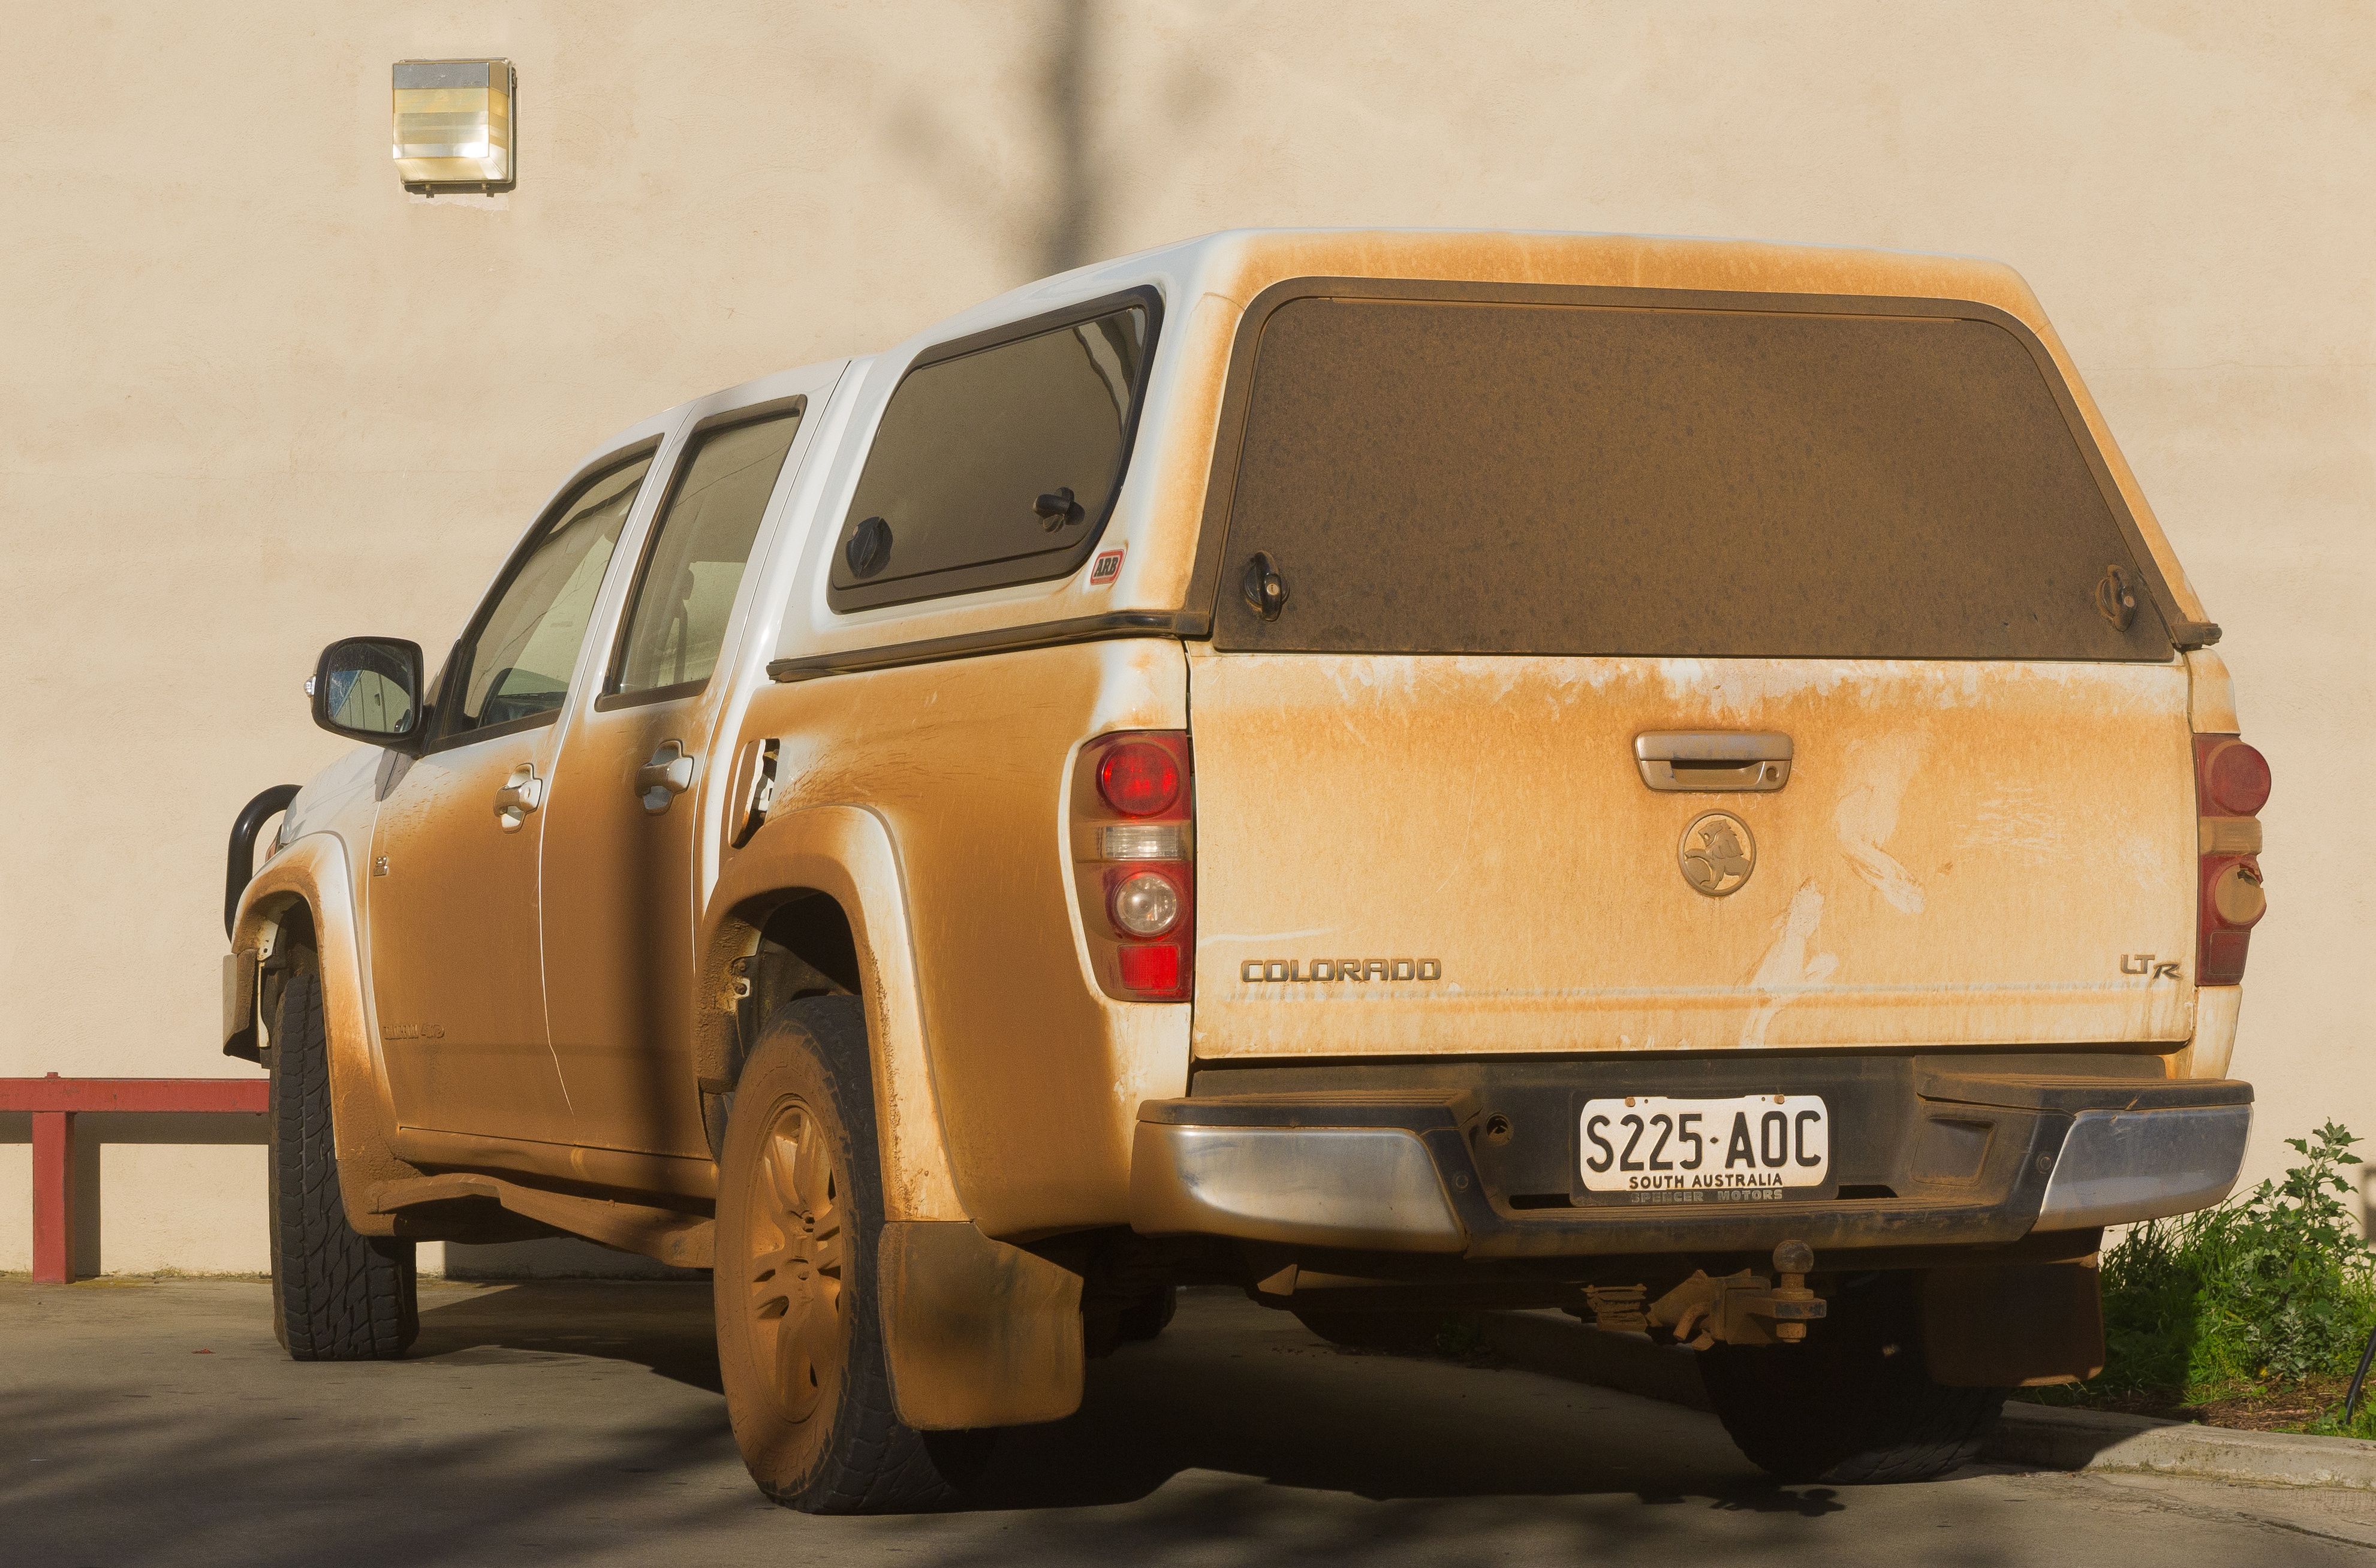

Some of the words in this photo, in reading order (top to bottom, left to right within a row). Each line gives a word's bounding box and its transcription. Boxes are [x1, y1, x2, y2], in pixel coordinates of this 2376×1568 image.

[1093, 557, 1119, 577] ARB
[1241, 958, 1441, 982] COLORADO
[1629, 1175, 1684, 1189] SOUTH
[1692, 1173, 1783, 1187] AUSTRALIA
[1632, 1191, 1704, 1203] SPENCER
[1717, 1189, 1783, 1201] MOTORS
